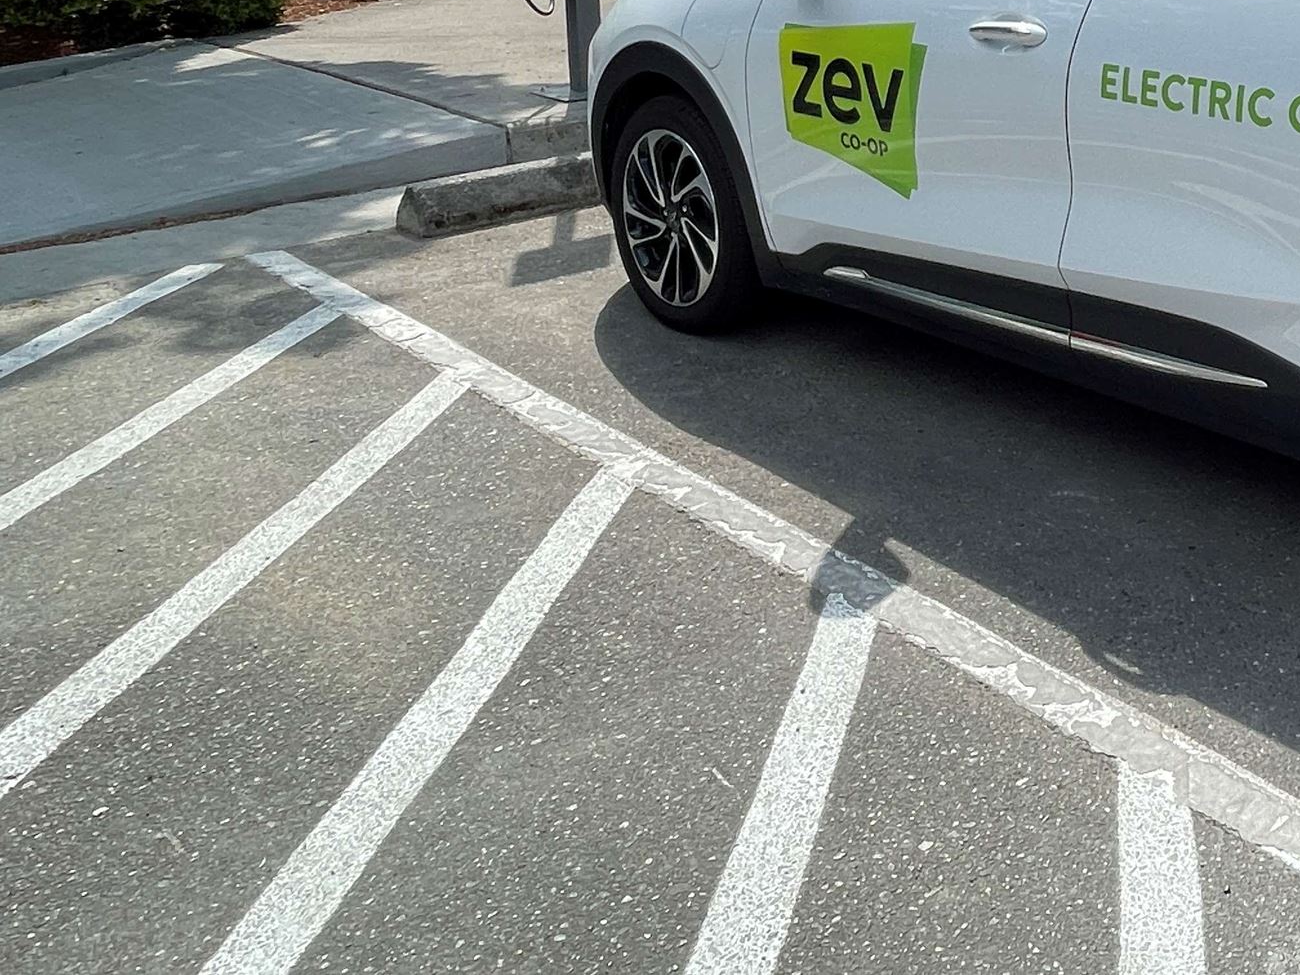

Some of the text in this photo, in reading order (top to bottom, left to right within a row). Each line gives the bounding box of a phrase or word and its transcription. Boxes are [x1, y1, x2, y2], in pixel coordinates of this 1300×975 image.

[791, 50, 904, 133] zev
[1100, 63, 1275, 127] ELECTRIC
[840, 131, 889, 157] CO-OP
